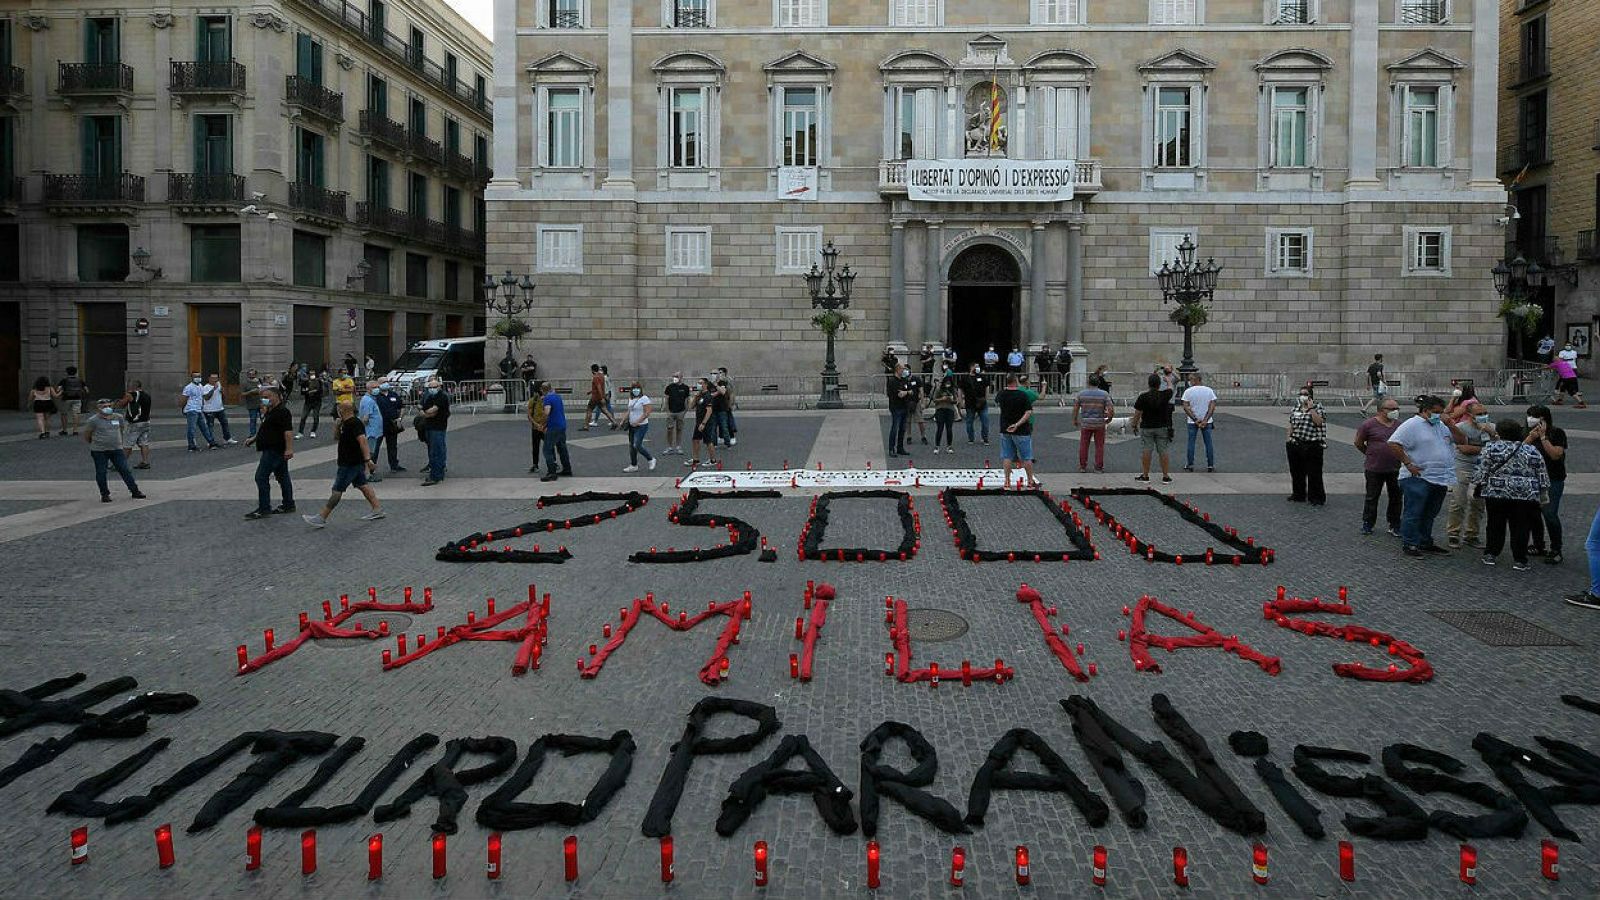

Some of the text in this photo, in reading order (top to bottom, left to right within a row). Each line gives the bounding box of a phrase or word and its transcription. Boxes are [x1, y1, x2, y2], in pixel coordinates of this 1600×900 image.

[911, 168, 954, 187] LLIBERTAT
[958, 165, 1000, 187] D'OPINIÓ
[1012, 165, 1070, 187] D'EXPRESSIÓ
[436, 487, 1275, 564] 25.000
[235, 585, 1434, 684] FAMILIAS
